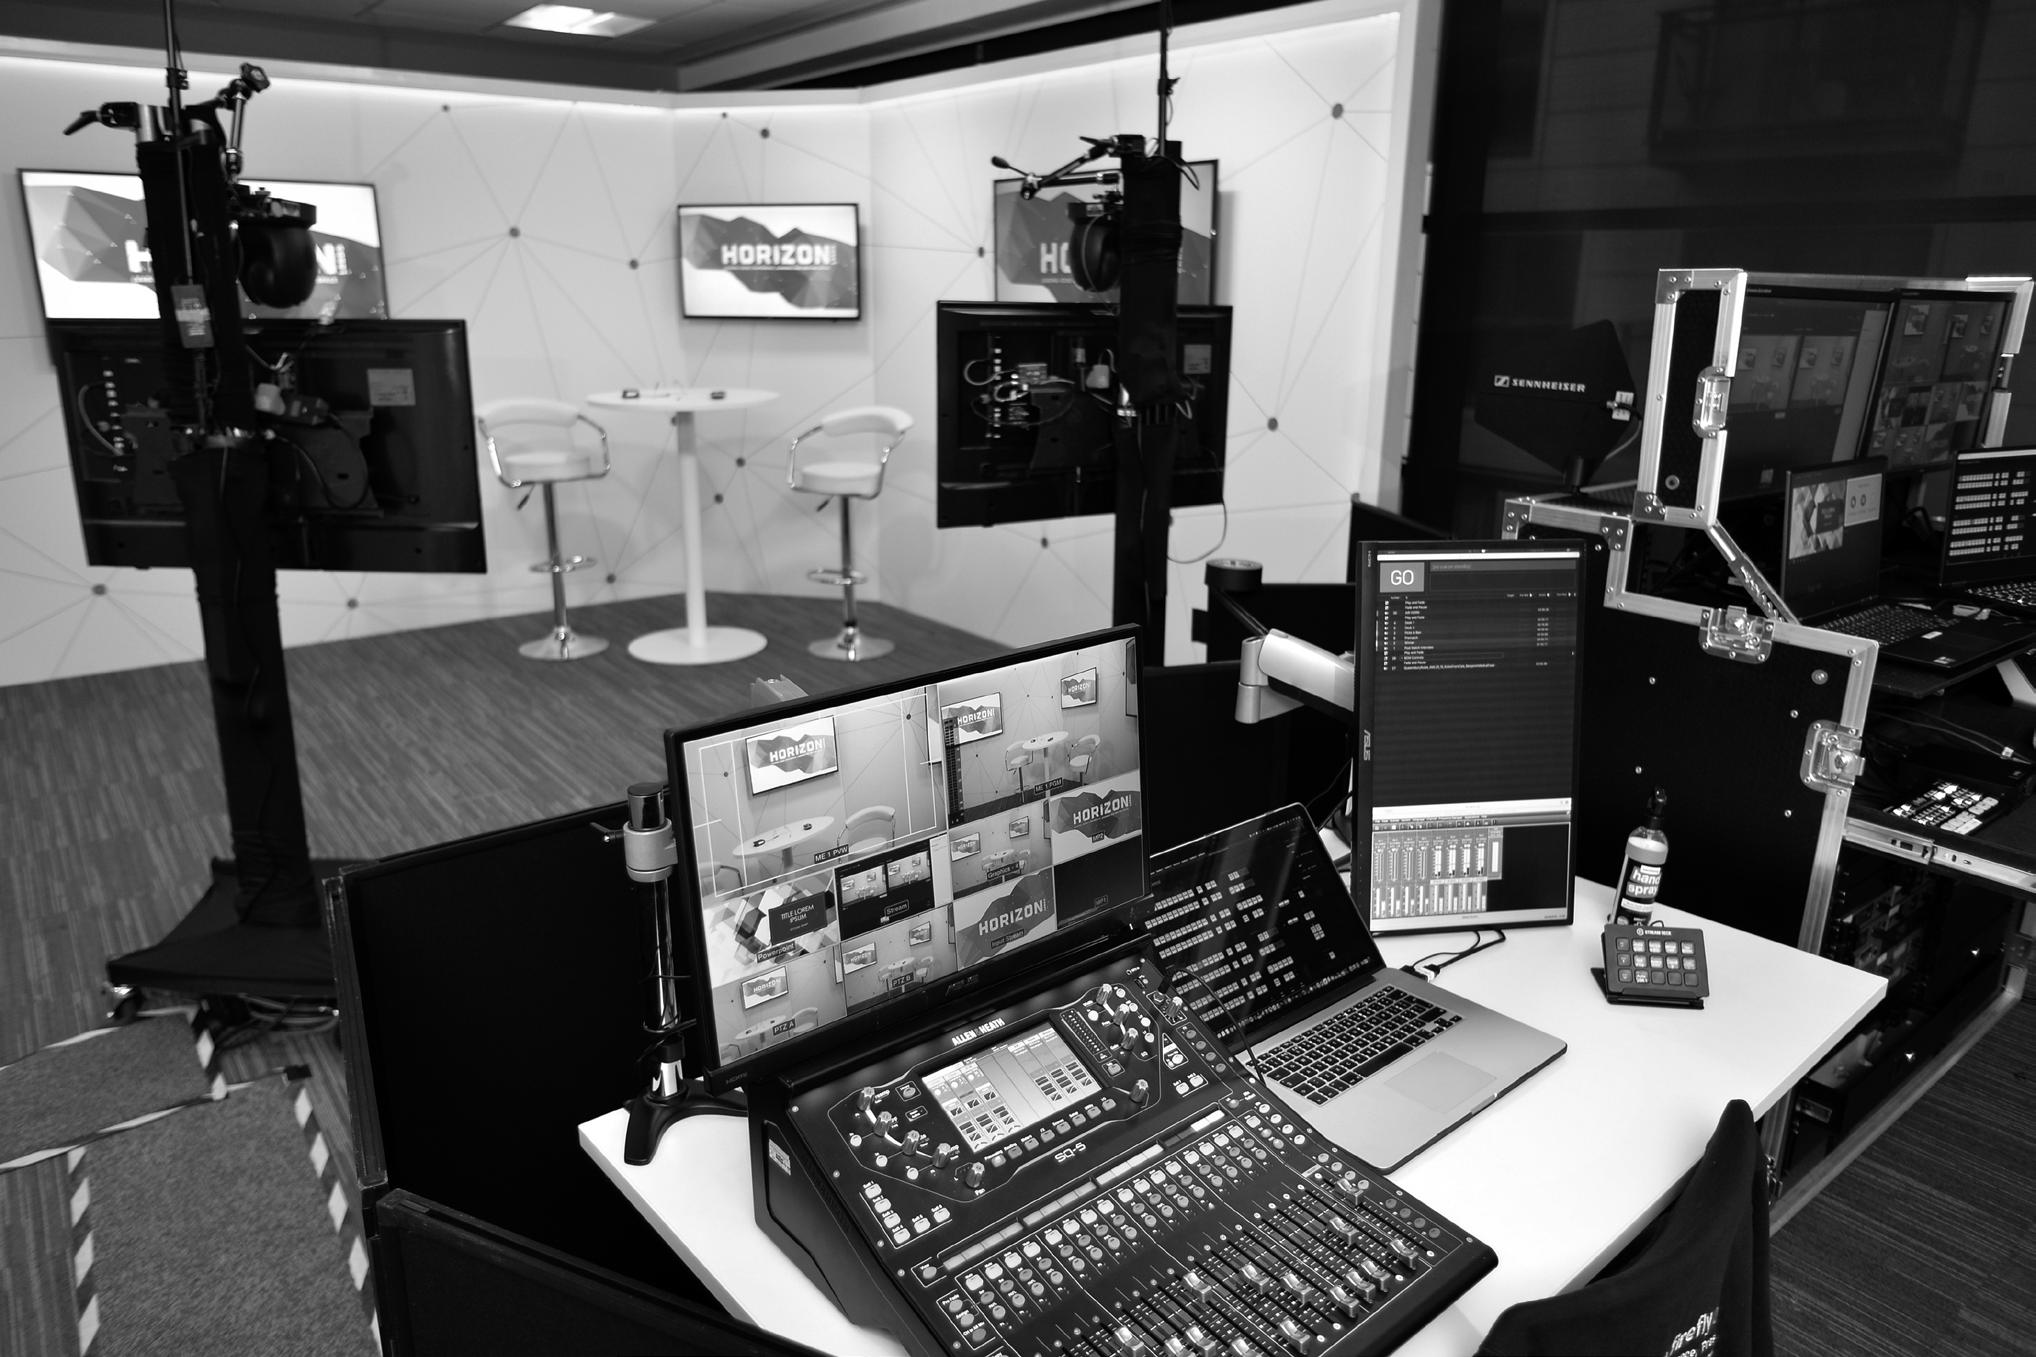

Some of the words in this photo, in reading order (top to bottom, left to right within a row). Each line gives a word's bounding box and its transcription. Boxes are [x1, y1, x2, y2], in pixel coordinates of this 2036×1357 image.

[721, 244, 830, 265] HORIZON
[1512, 378, 1586, 392] SENNHEISER
[1390, 570, 1414, 585] GO
[957, 708, 993, 725] HORIZON
[769, 739, 822, 762] HORIZON
[1073, 795, 1129, 825] HORIZON
[781, 910, 794, 920] TITLE
[794, 904, 815, 915] LOREM
[886, 903, 908, 915] Stream
[979, 899, 1043, 936] HORIZON
